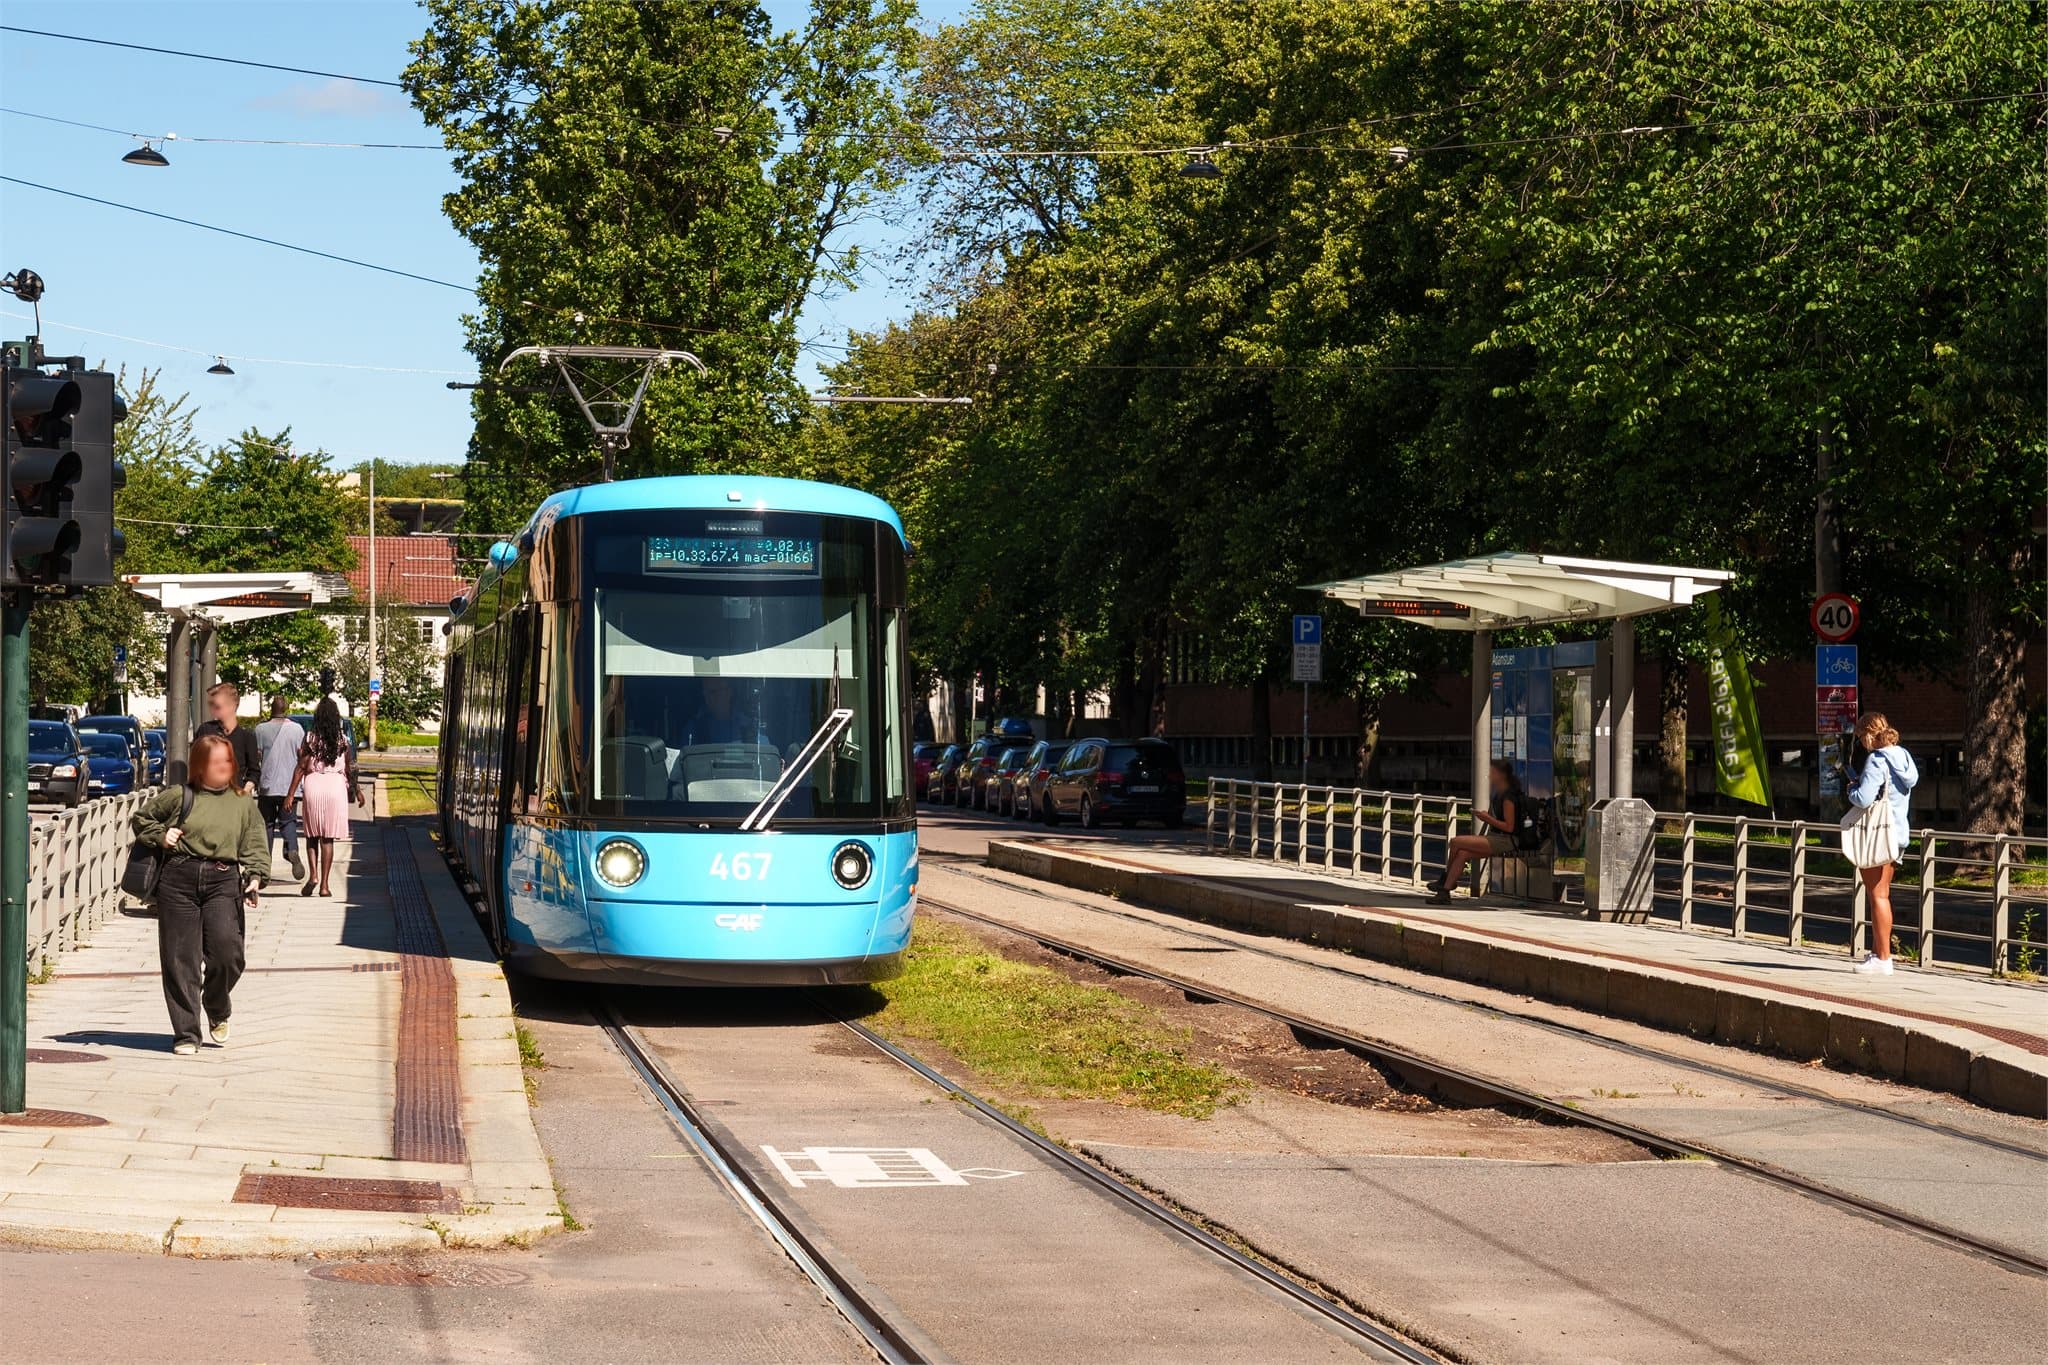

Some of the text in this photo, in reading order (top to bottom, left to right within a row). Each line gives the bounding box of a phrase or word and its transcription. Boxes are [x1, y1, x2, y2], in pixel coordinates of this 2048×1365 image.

[1820, 606, 1852, 629] 40
[1300, 619, 1314, 641] P
[709, 851, 773, 881] 467
[714, 912, 765, 932] CAF
